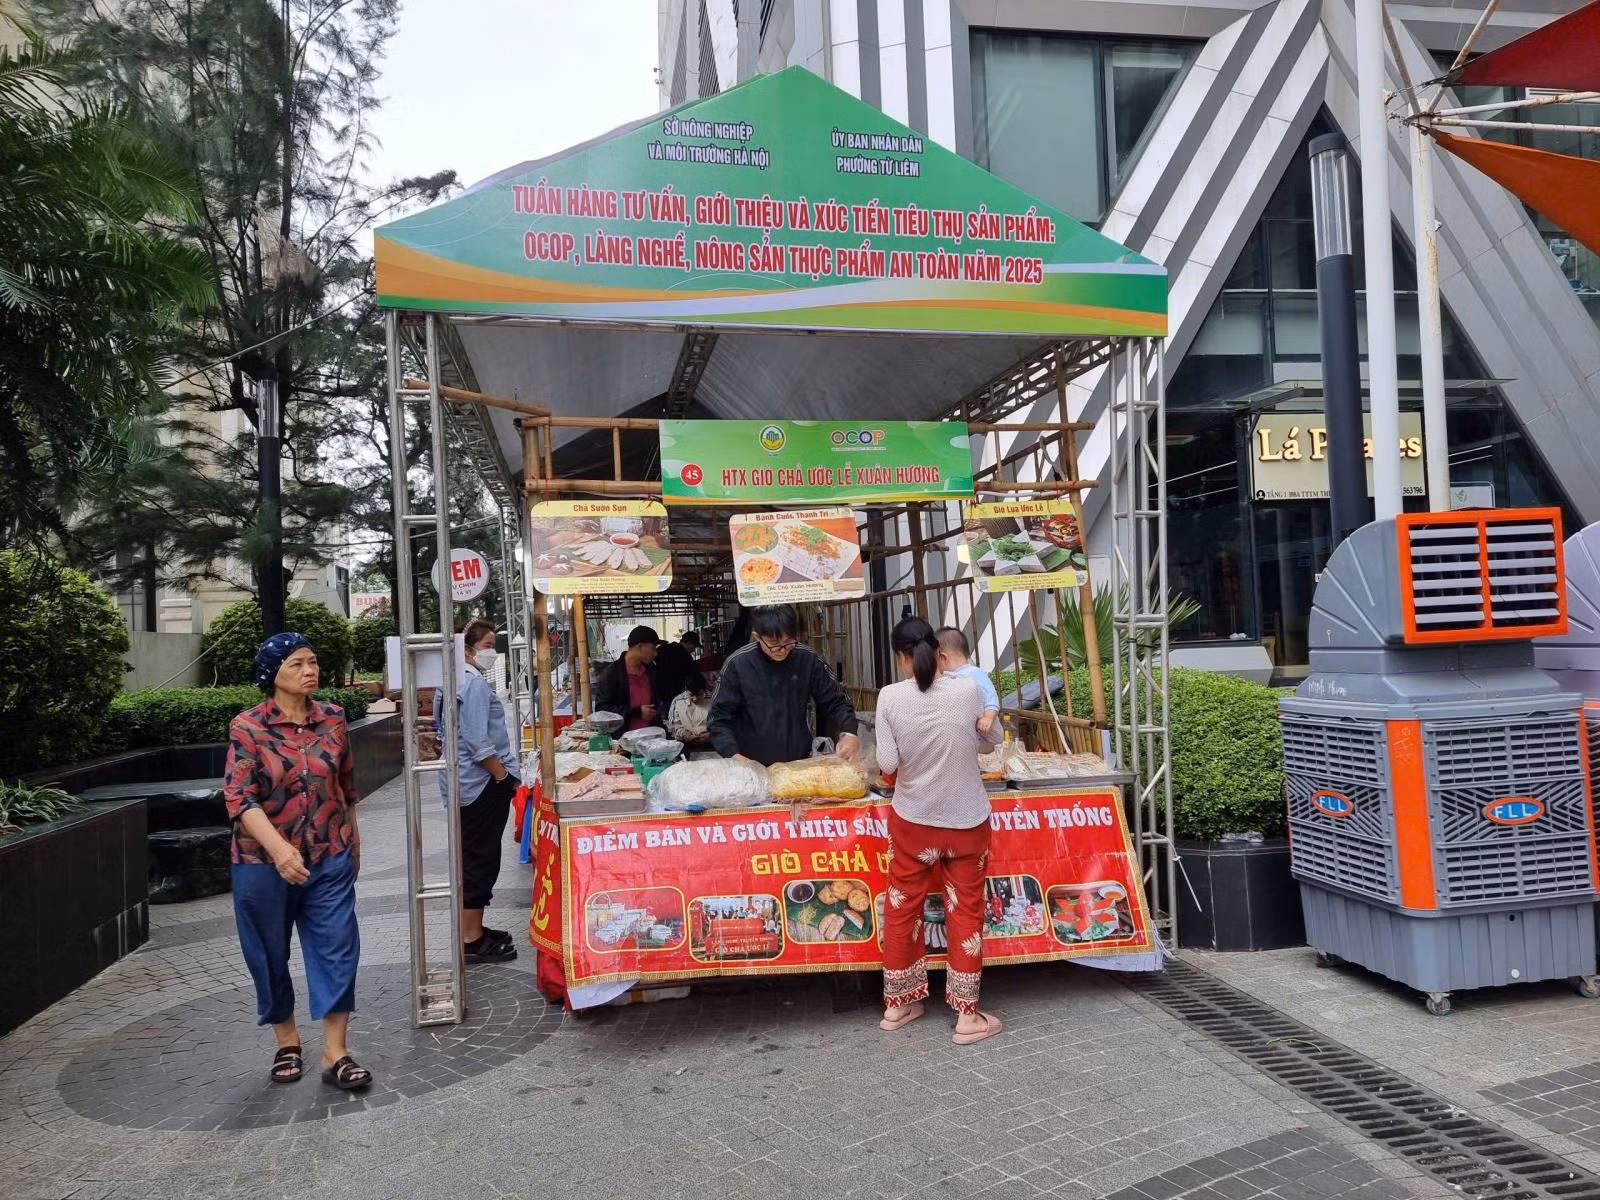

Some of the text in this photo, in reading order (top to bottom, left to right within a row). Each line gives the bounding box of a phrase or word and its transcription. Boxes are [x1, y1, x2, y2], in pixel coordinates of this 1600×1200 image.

[664, 115, 754, 144] SỞ NÔNG NGHIỆP
[832, 126, 923, 154] ỦY BAN NHÂN DÂN
[648, 140, 770, 170] VÀ MÔI TRƯỜNG HÀ NỘI
[836, 154, 920, 177] PHƯỜNG TỪ LIÊM
[512, 177, 1055, 244] TUẦN HÀNG TƯ VẤN, GIỚI THIỆU VÀ XÚC TIẾN TIÊU THỤ SẢN PHẨM:
[524, 228, 1043, 284] OCOP, LÀNG NGHỀ, NÔNG SẢN THỰC PHẨM AN TOÀN NĂM 2025
[831, 430, 885, 446] OCOP
[1257, 426, 1302, 461] Lá
[685, 469, 699, 480] 45
[722, 468, 747, 486] HTX
[752, 464, 774, 486] GIÒ
[777, 463, 804, 486] CHẢ
[857, 464, 892, 485] XUÂN
[896, 465, 940, 484] HƯƠNG
[451, 558, 482, 582] EM
[1319, 796, 1345, 812] FLL
[1494, 803, 1534, 818] FLL
[577, 828, 639, 854] ĐIỂM
[645, 826, 691, 848] BÁN
[696, 822, 727, 844] VÀ
[732, 819, 780, 842] GIỚI
[785, 815, 848, 842] THIỆU
[853, 812, 888, 838] SẢN
[990, 804, 1040, 831] UYỀN
[1043, 801, 1113, 828] THỐNG
[751, 848, 801, 875] GIÒ
[811, 844, 870, 873] CHẢ
